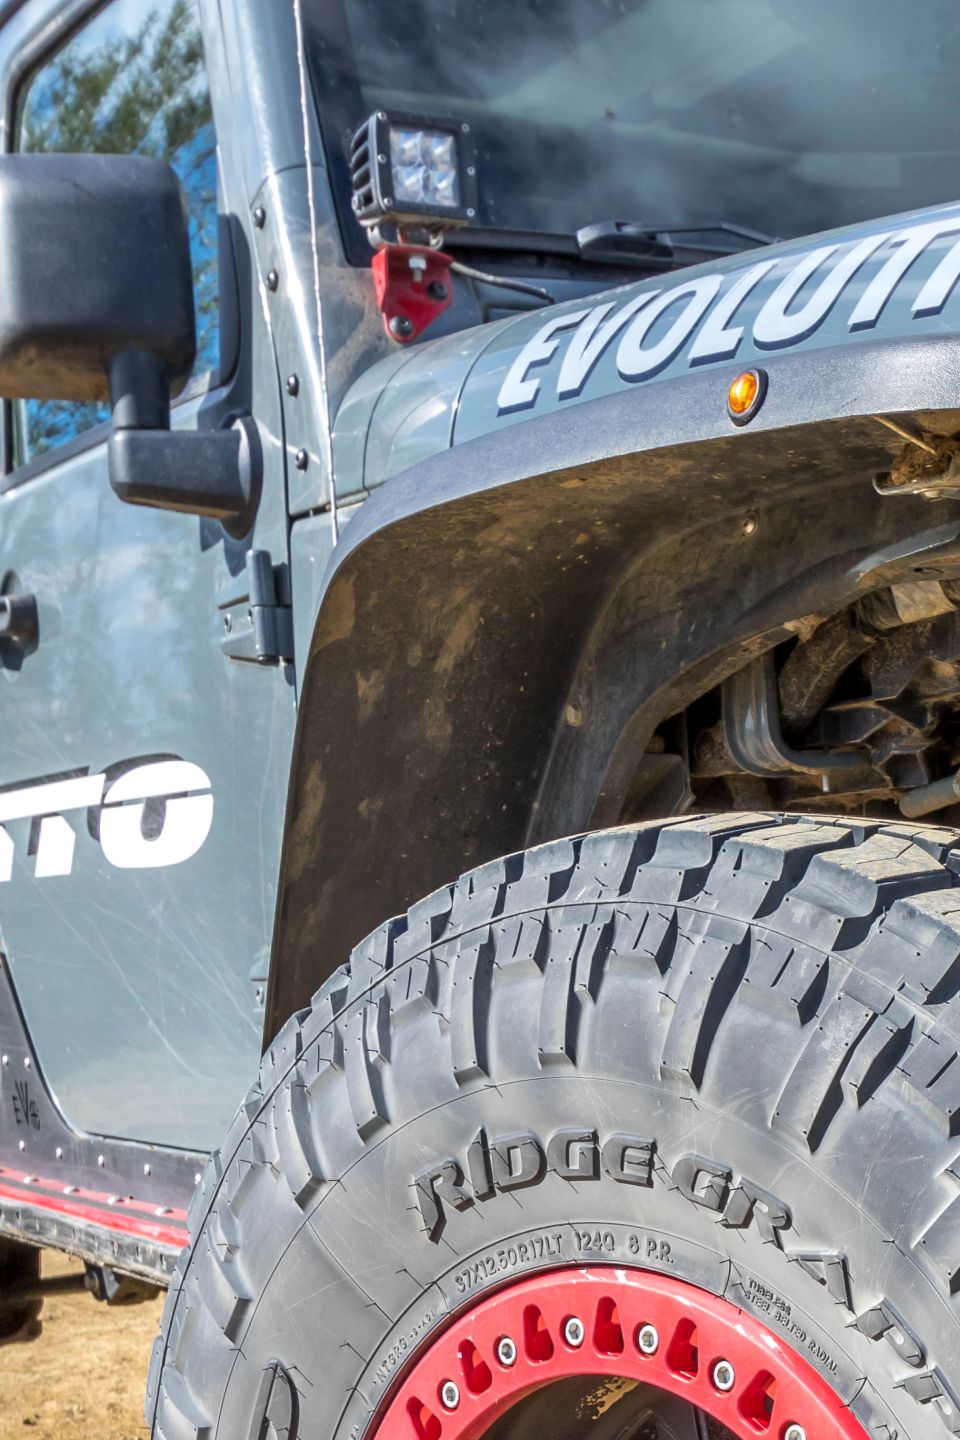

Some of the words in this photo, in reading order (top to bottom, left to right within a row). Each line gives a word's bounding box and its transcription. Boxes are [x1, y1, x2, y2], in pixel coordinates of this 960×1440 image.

[412, 1124, 658, 1243] RIDGE
[574, 1230, 615, 1252] 124Q
[628, 1232, 640, 1254] 8
[808, 1339, 839, 1373] RADIAL
